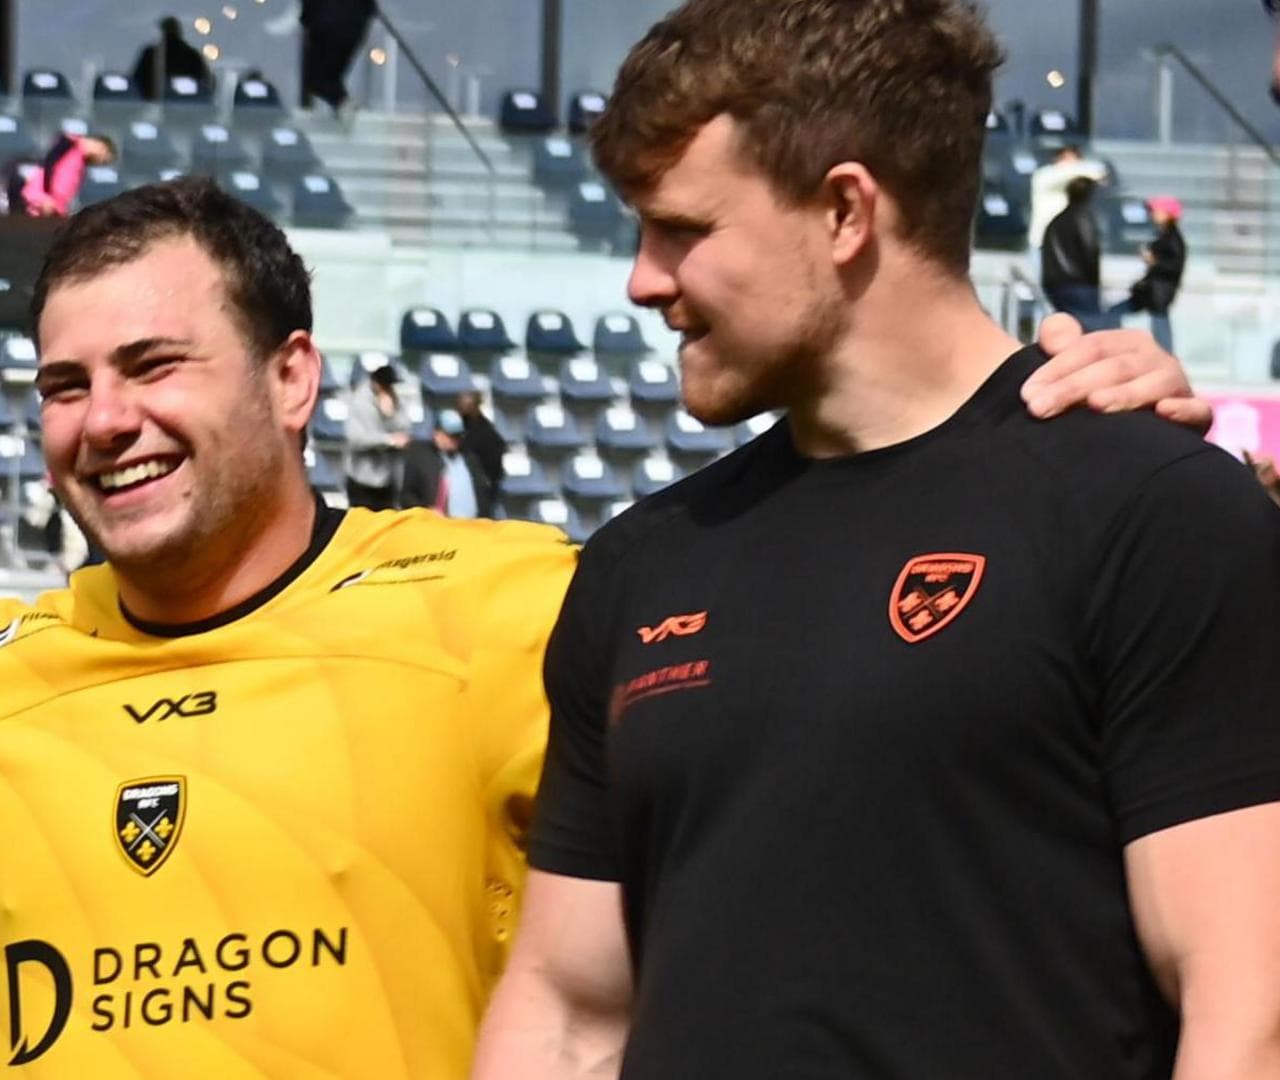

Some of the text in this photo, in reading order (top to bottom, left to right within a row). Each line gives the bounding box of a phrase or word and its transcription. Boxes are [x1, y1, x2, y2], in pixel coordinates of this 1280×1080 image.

[375, 549, 457, 570] zgerald
[122, 690, 217, 724] VX3
[92, 926, 349, 985] DRAGON
[91, 980, 253, 1032] SIGNS
